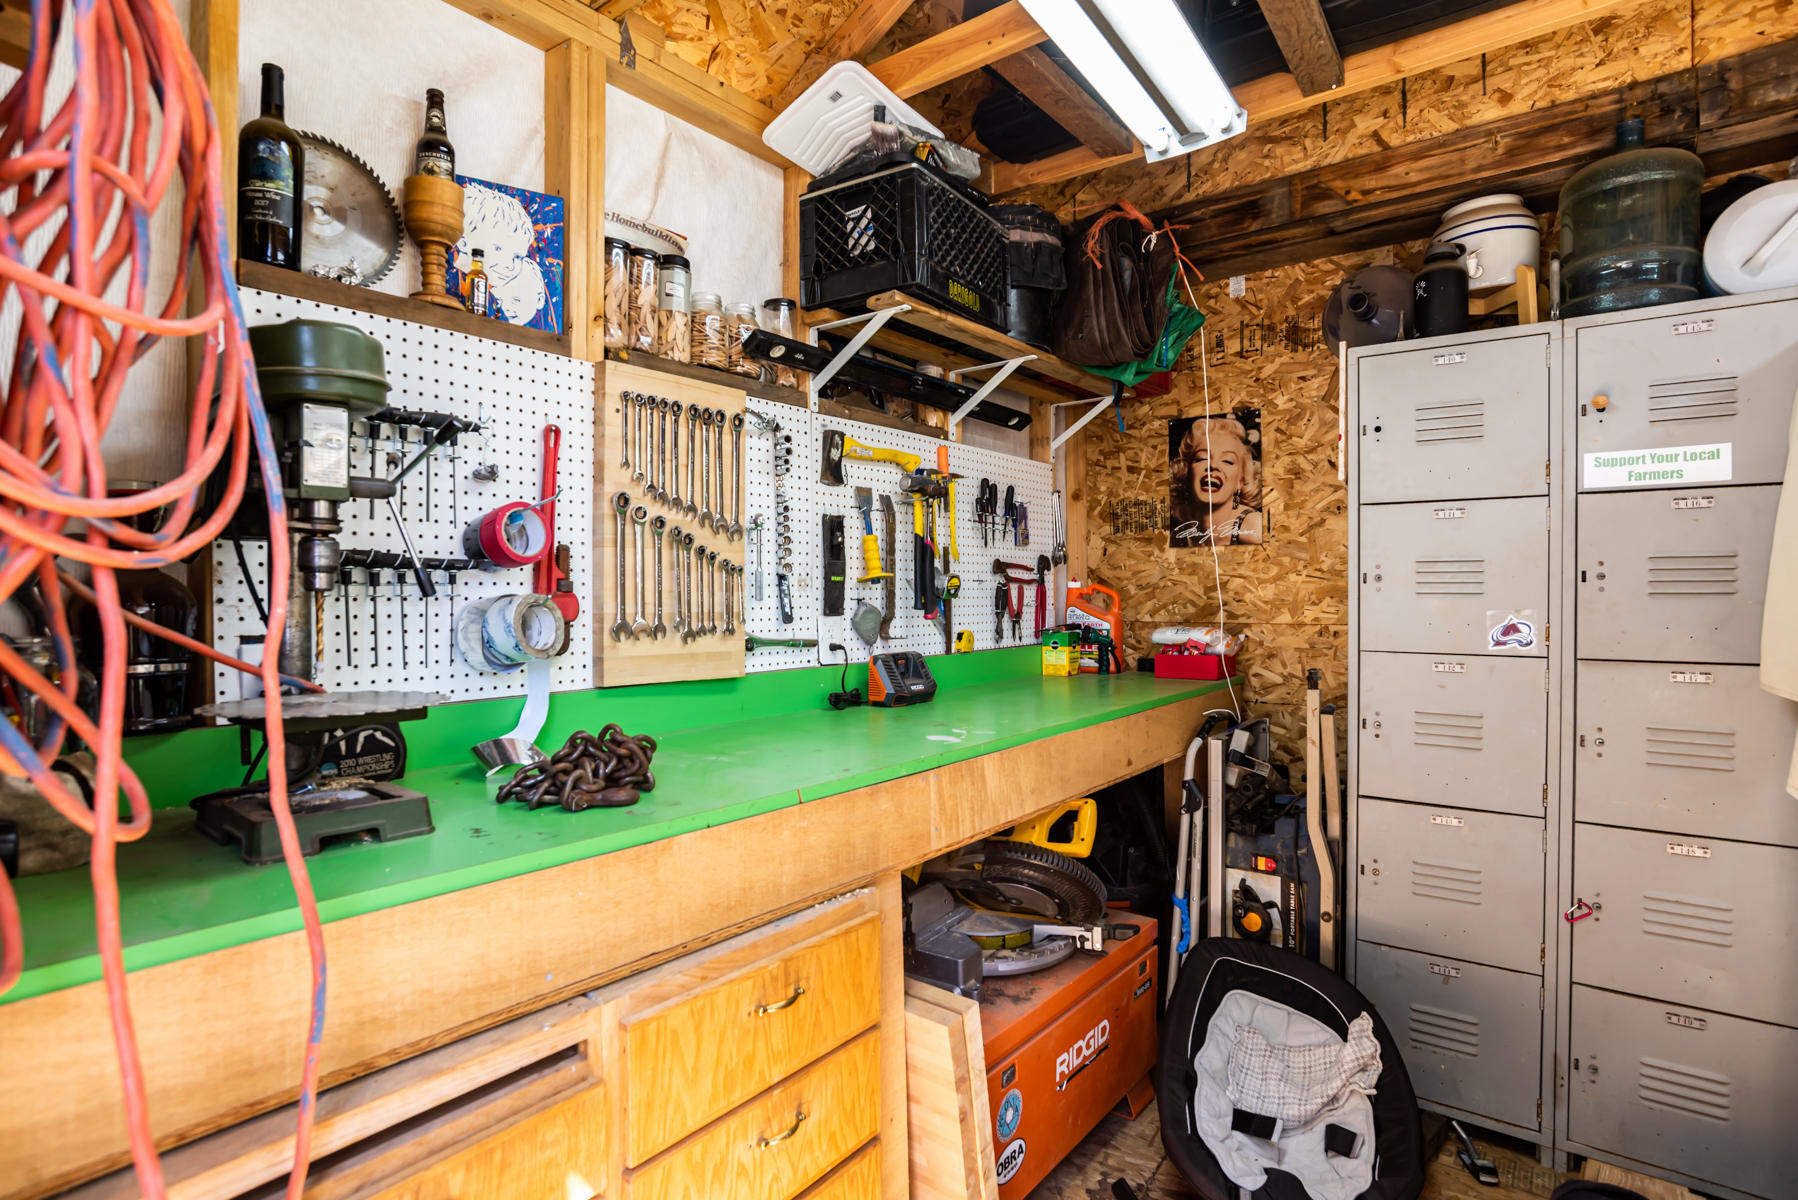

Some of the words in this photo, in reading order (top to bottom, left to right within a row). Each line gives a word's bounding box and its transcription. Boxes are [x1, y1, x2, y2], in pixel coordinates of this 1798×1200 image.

[1594, 454, 1647, 468] Support
[1650, 452, 1680, 464] Your
[1683, 448, 1721, 462] Local
[1627, 469, 1684, 482] Farmers
[340, 758, 357, 768] 2010
[357, 752, 395, 766] WRESTLING
[341, 761, 396, 776] CHAMPIONSHIPS
[1055, 1018, 1110, 1083] RIDGID
[996, 1143, 1025, 1177] OBRA
